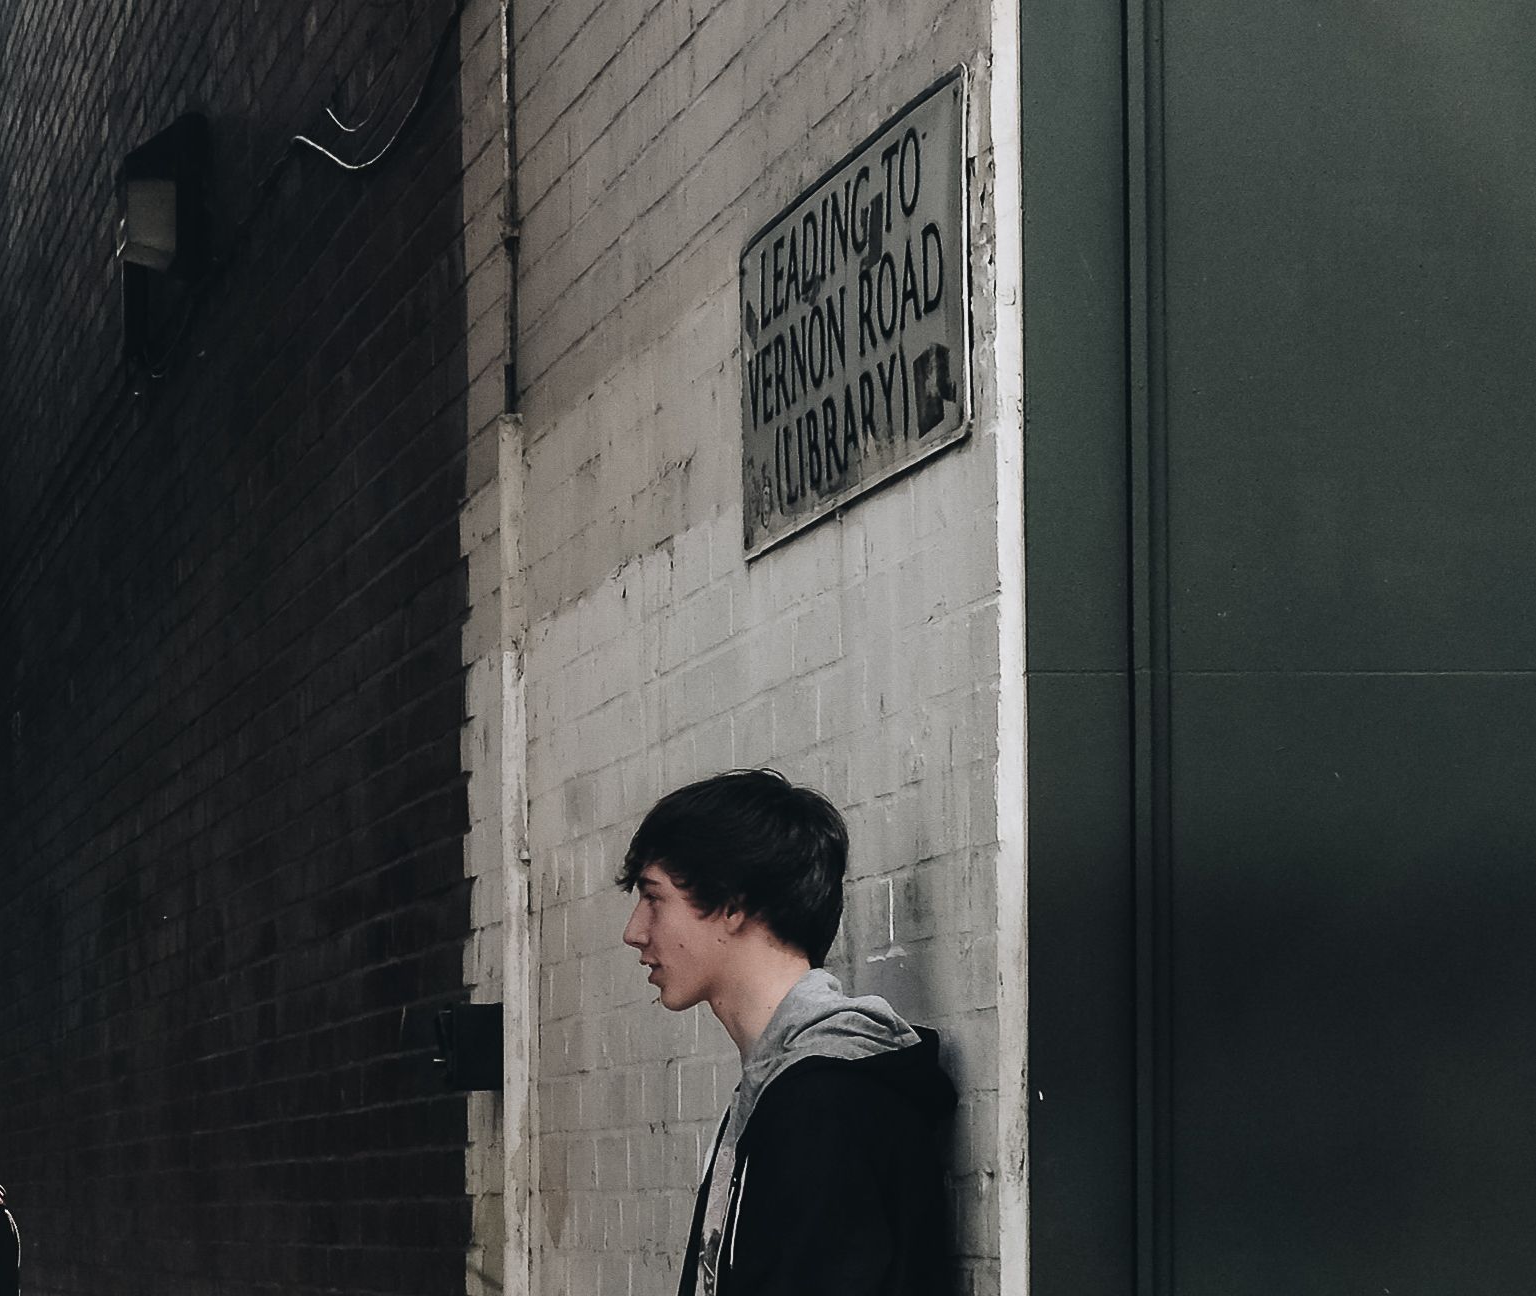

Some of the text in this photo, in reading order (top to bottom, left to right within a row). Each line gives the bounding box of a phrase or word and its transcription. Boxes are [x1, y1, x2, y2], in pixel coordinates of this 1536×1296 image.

[747, 222, 943, 432] VERNON ROAD
[760, 127, 920, 330] LEADING TO
[775, 344, 909, 516] (LIBRARY)
